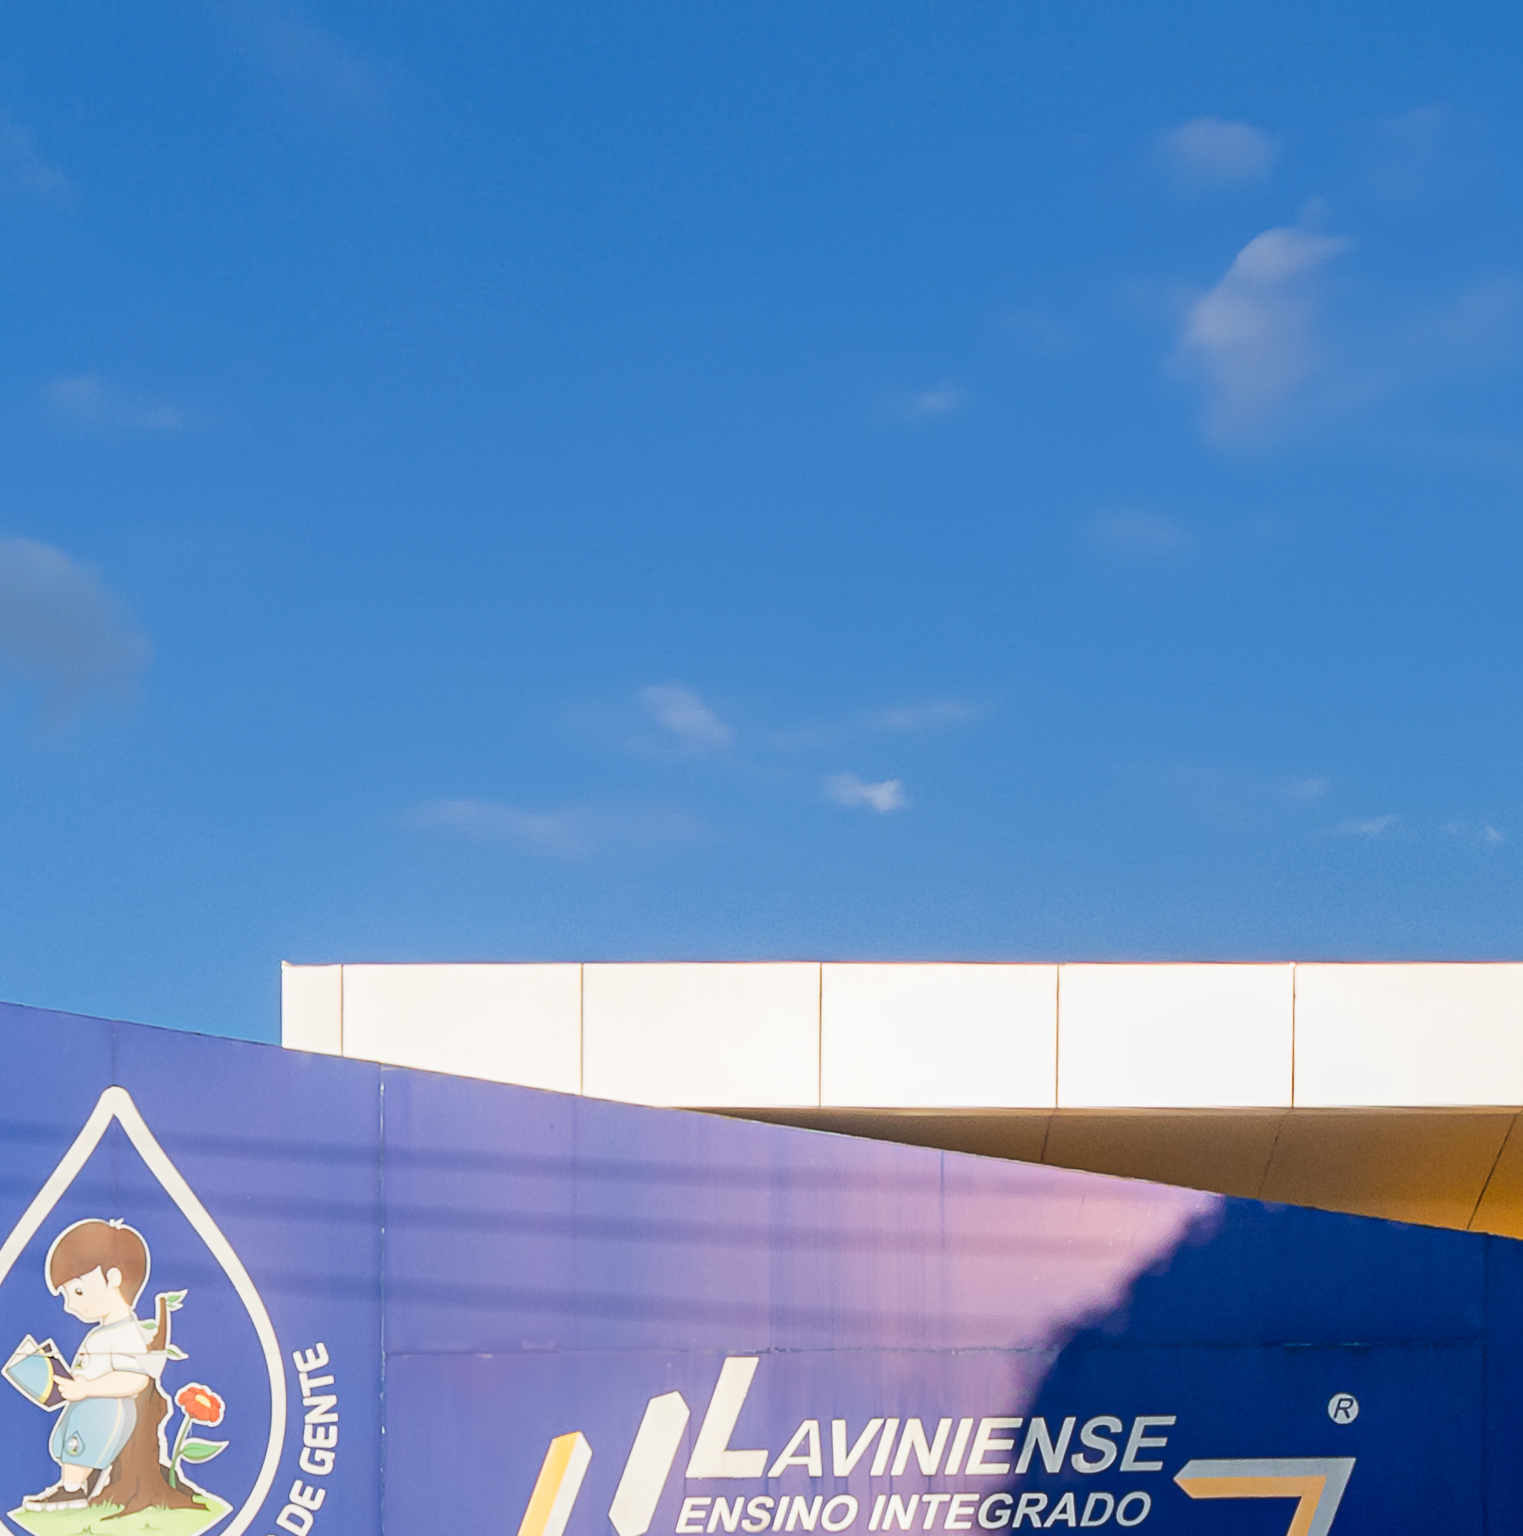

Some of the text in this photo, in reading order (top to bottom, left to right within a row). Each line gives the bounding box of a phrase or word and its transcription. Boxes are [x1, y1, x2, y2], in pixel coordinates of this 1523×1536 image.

[292, 1342, 339, 1475] GENTE
[685, 1356, 1176, 1478] LAVINIENSE
[675, 1491, 1152, 1534] ENSINO INTEGRADO
